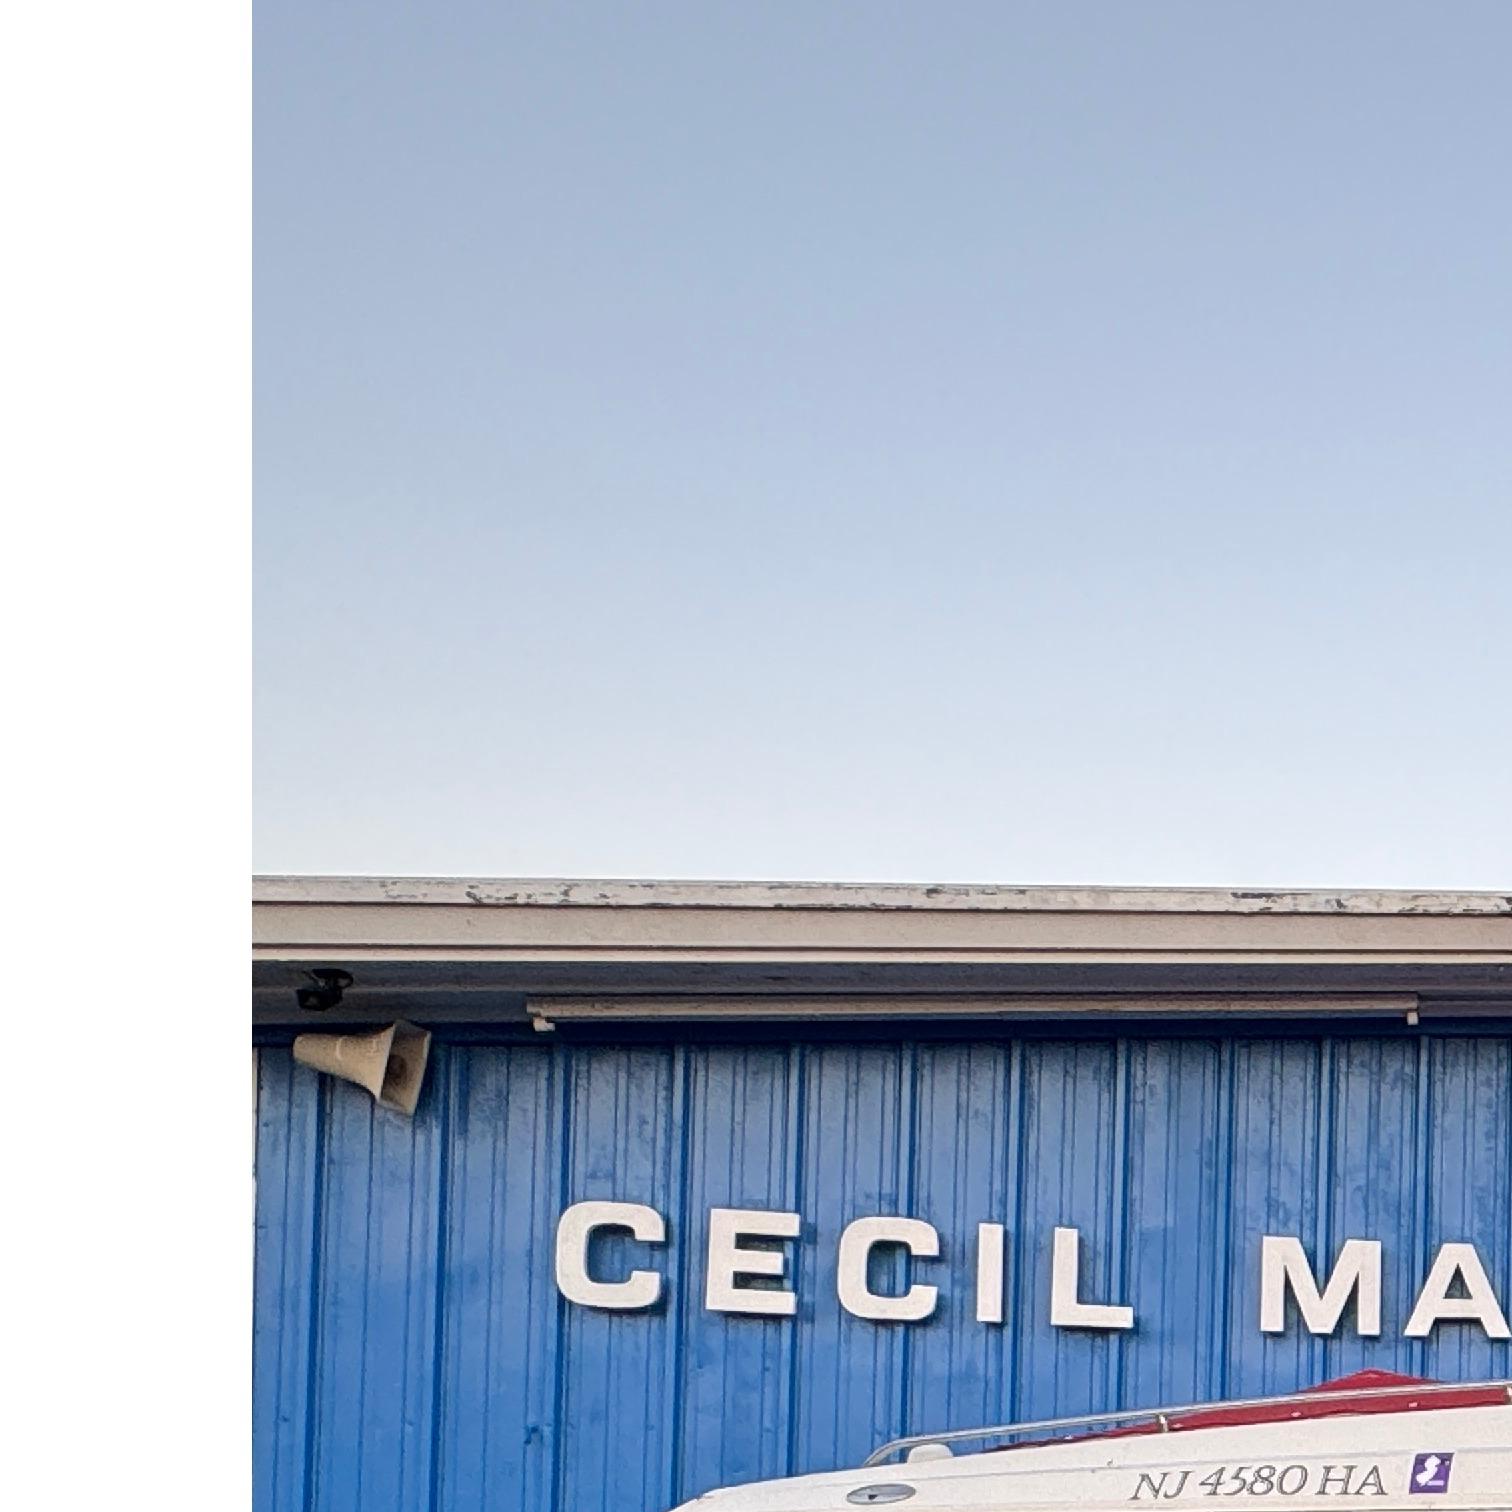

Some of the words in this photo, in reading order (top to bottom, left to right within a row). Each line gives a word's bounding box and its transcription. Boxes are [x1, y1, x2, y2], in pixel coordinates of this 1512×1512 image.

[556, 1200, 1135, 1330] CECIL
[1131, 1469, 1194, 1501] NJ
[1199, 1463, 1308, 1496] 4580
[1315, 1463, 1388, 1496] HA
